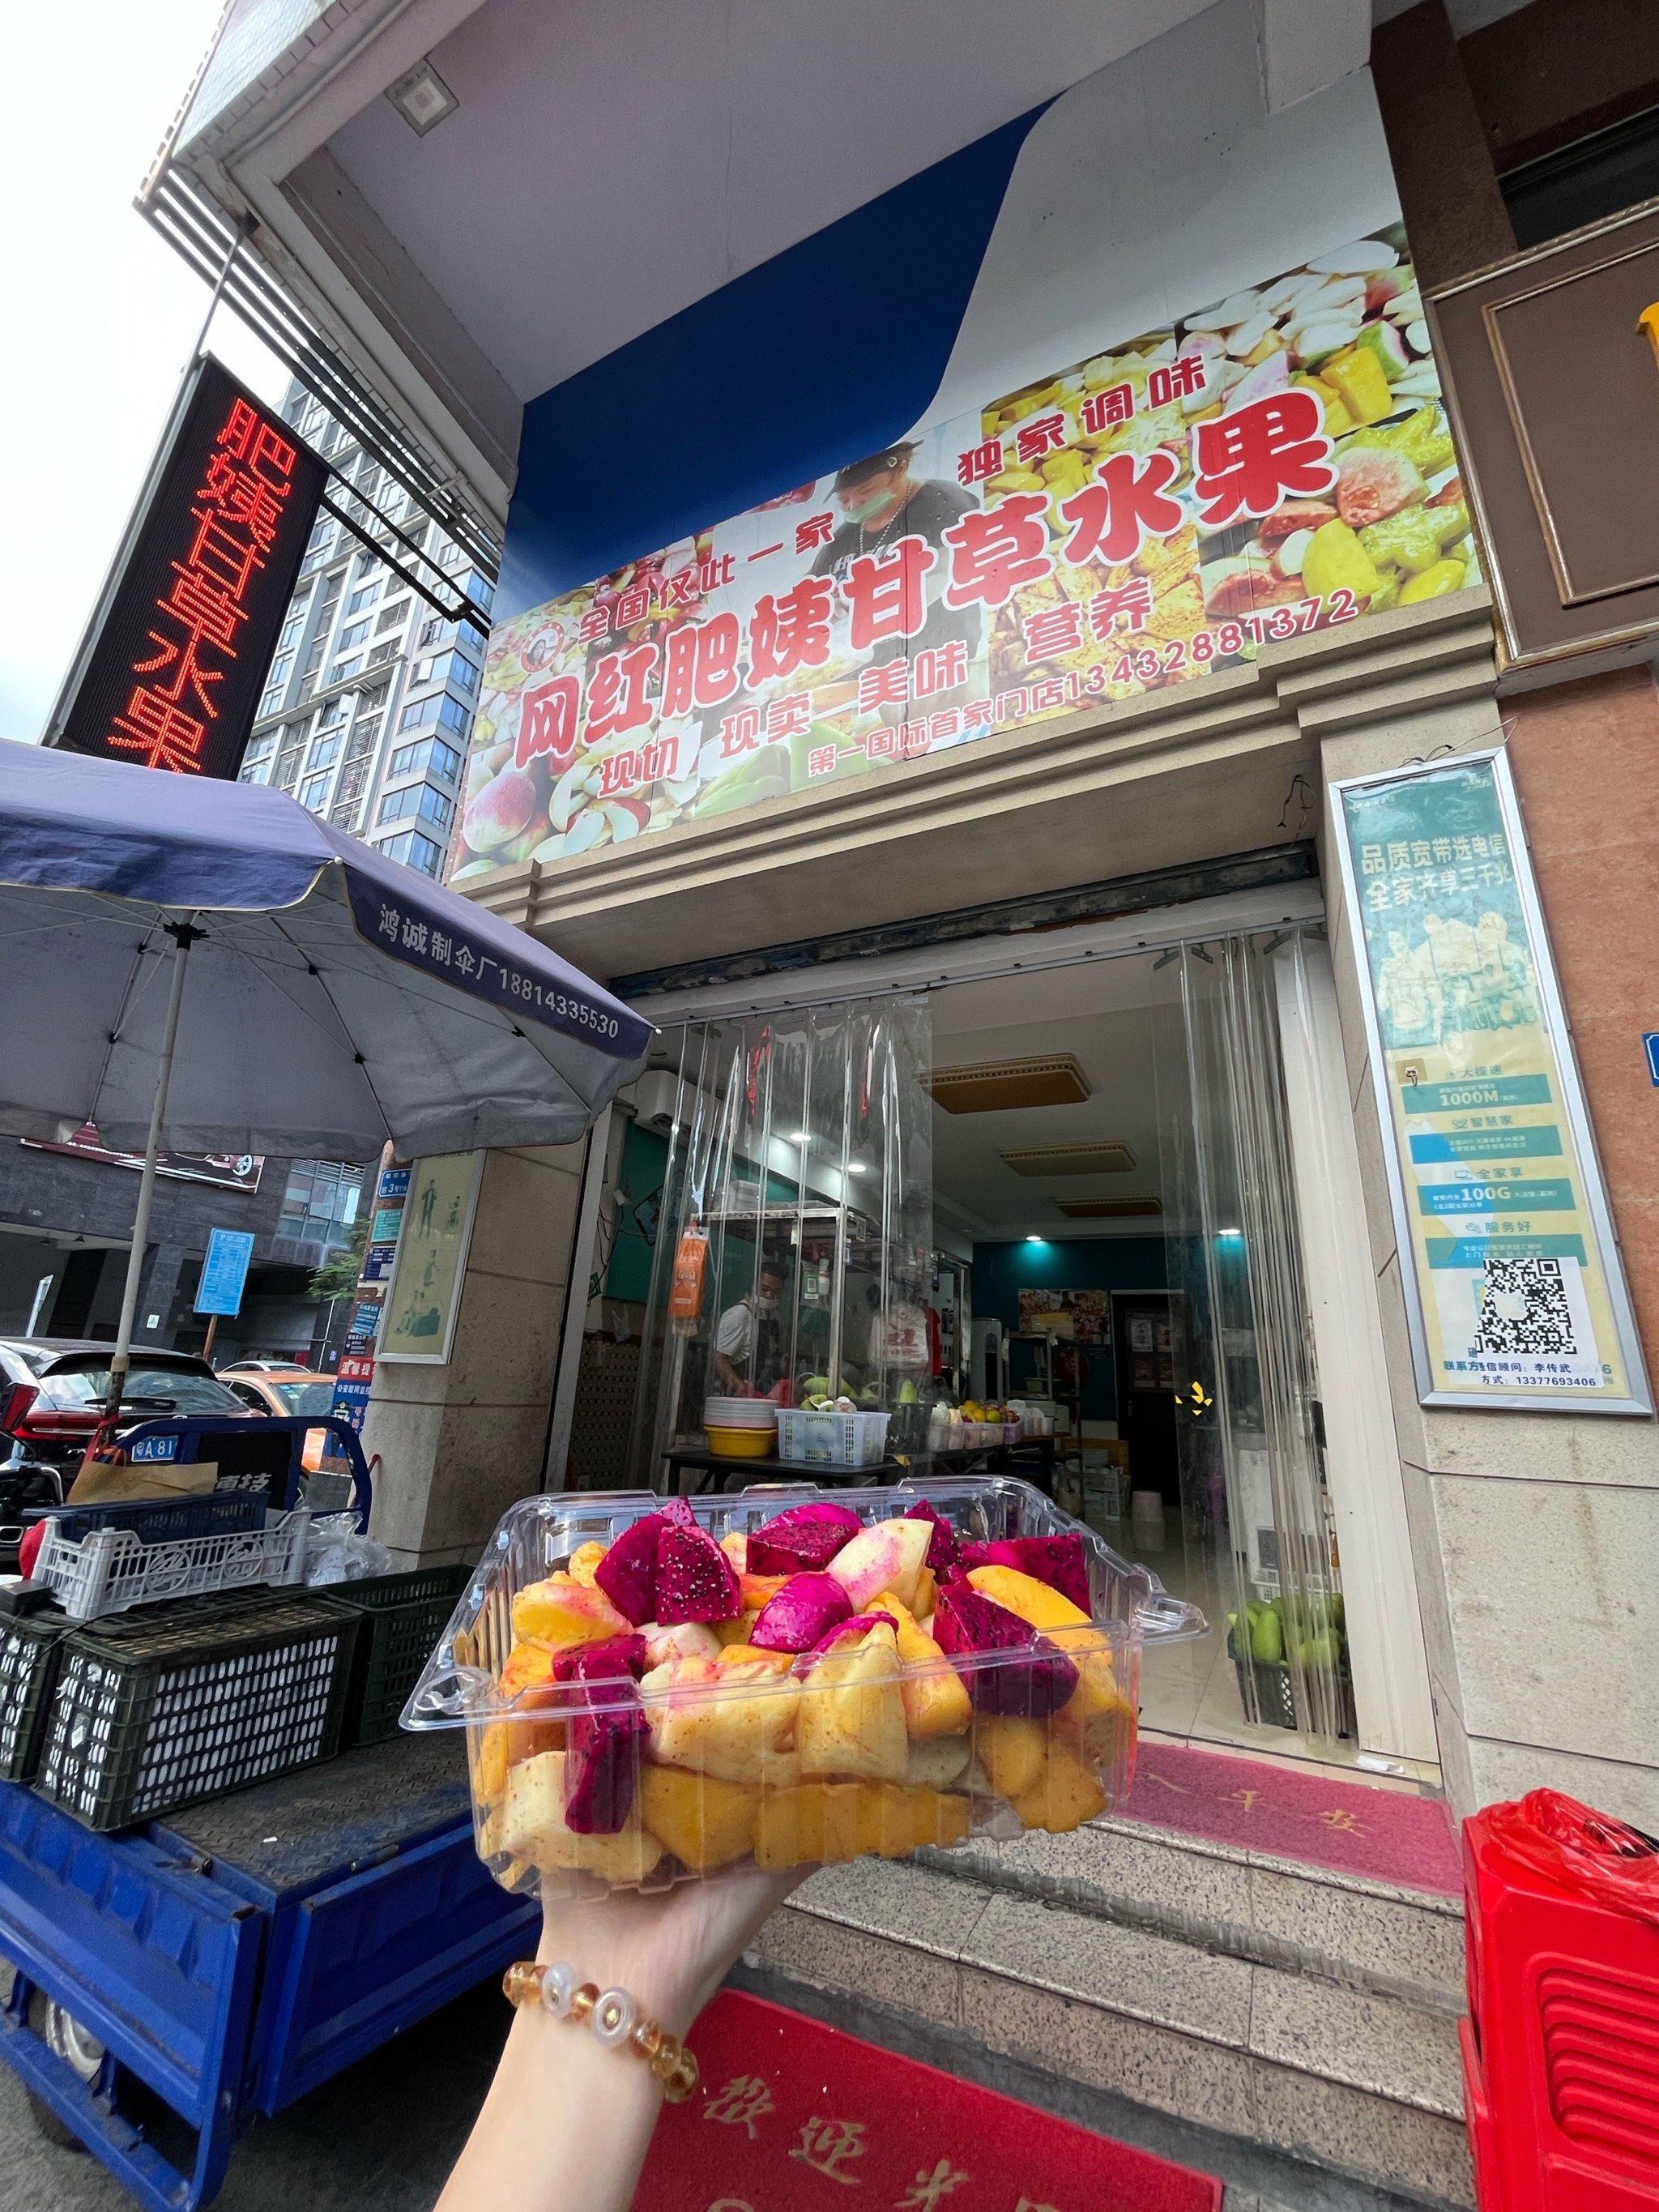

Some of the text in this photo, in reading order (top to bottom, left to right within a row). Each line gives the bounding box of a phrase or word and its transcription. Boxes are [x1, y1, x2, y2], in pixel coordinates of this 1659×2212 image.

[957, 355, 1206, 485] 独家调味
[107, 397, 297, 774] 肥姨甘草水果
[514, 391, 1335, 768] 网红肥姨甘草水果
[578, 511, 834, 645] 全国仅此一家
[598, 579, 1153, 798] 现切 现卖 美味 营养
[1361, 832, 1507, 875] 品质宽带选电信
[1440, 1089, 1499, 1107] 1000M
[1461, 1186, 1512, 1202] 100G
[1478, 1167, 1524, 1180] 全家享
[1485, 1220, 1531, 1232] 服务好
